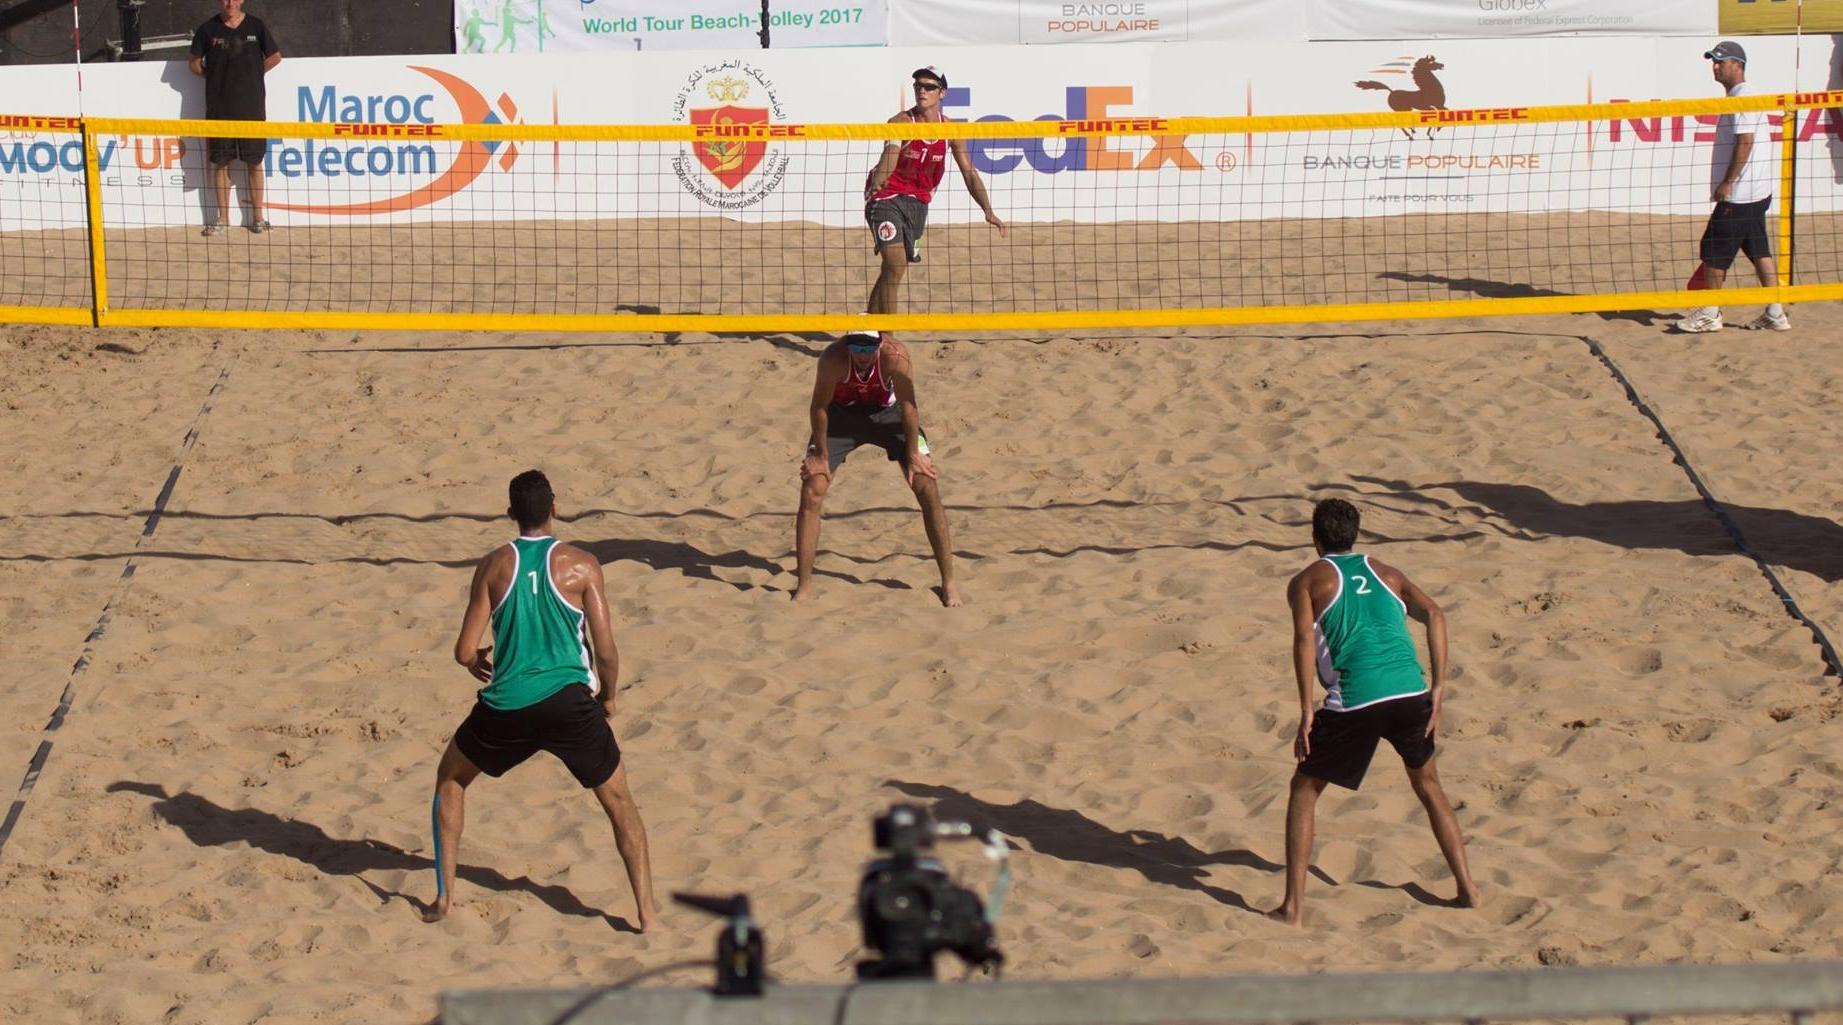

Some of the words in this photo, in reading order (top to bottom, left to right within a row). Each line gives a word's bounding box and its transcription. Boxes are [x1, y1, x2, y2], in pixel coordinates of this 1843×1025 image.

[1062, 3, 1145, 17] BANQUE
[583, 17, 637, 33] World
[643, 15, 684, 31] Tour
[819, 8, 863, 24] 2017
[1047, 19, 1160, 33] POPULAIRE
[297, 85, 434, 124] Maroc
[1420, 107, 1528, 123] FUNTEC
[334, 123, 443, 136] FUNTEC
[696, 124, 805, 137] FUNTEC
[1059, 119, 1168, 133] FUNTEC
[1303, 155, 1401, 170] BANQUE
[1407, 154, 1540, 169] POPULAIRE
[0, 175, 186, 188] ITNESS
[528, 571, 538, 594] 1
[1351, 576, 1372, 594] 2
